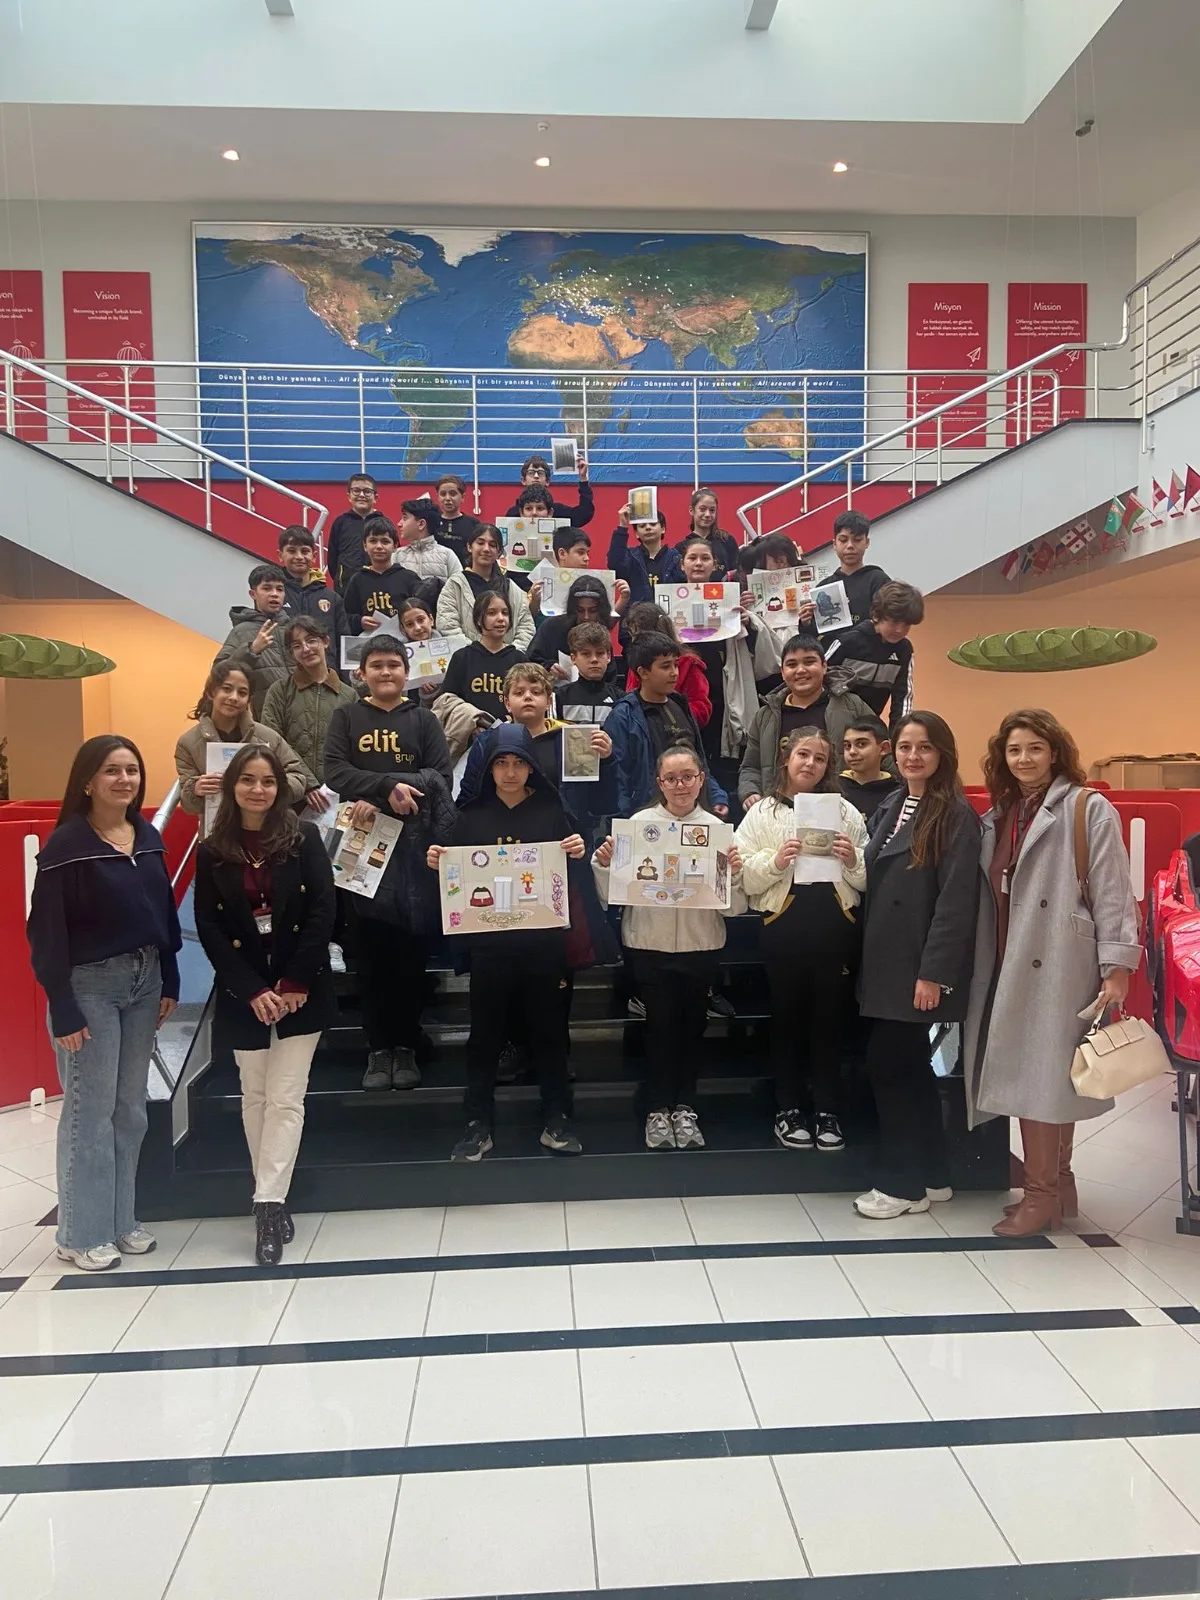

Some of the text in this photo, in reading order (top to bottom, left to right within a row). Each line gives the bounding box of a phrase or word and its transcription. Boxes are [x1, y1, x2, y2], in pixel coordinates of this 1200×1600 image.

[94, 290, 120, 300] Vision
[934, 302, 962, 314] Misyon
[1034, 302, 1062, 310] Mission
[366, 591, 393, 612] elit
[471, 672, 503, 694] elit
[358, 728, 400, 752] elit
[395, 753, 415, 765] grup
